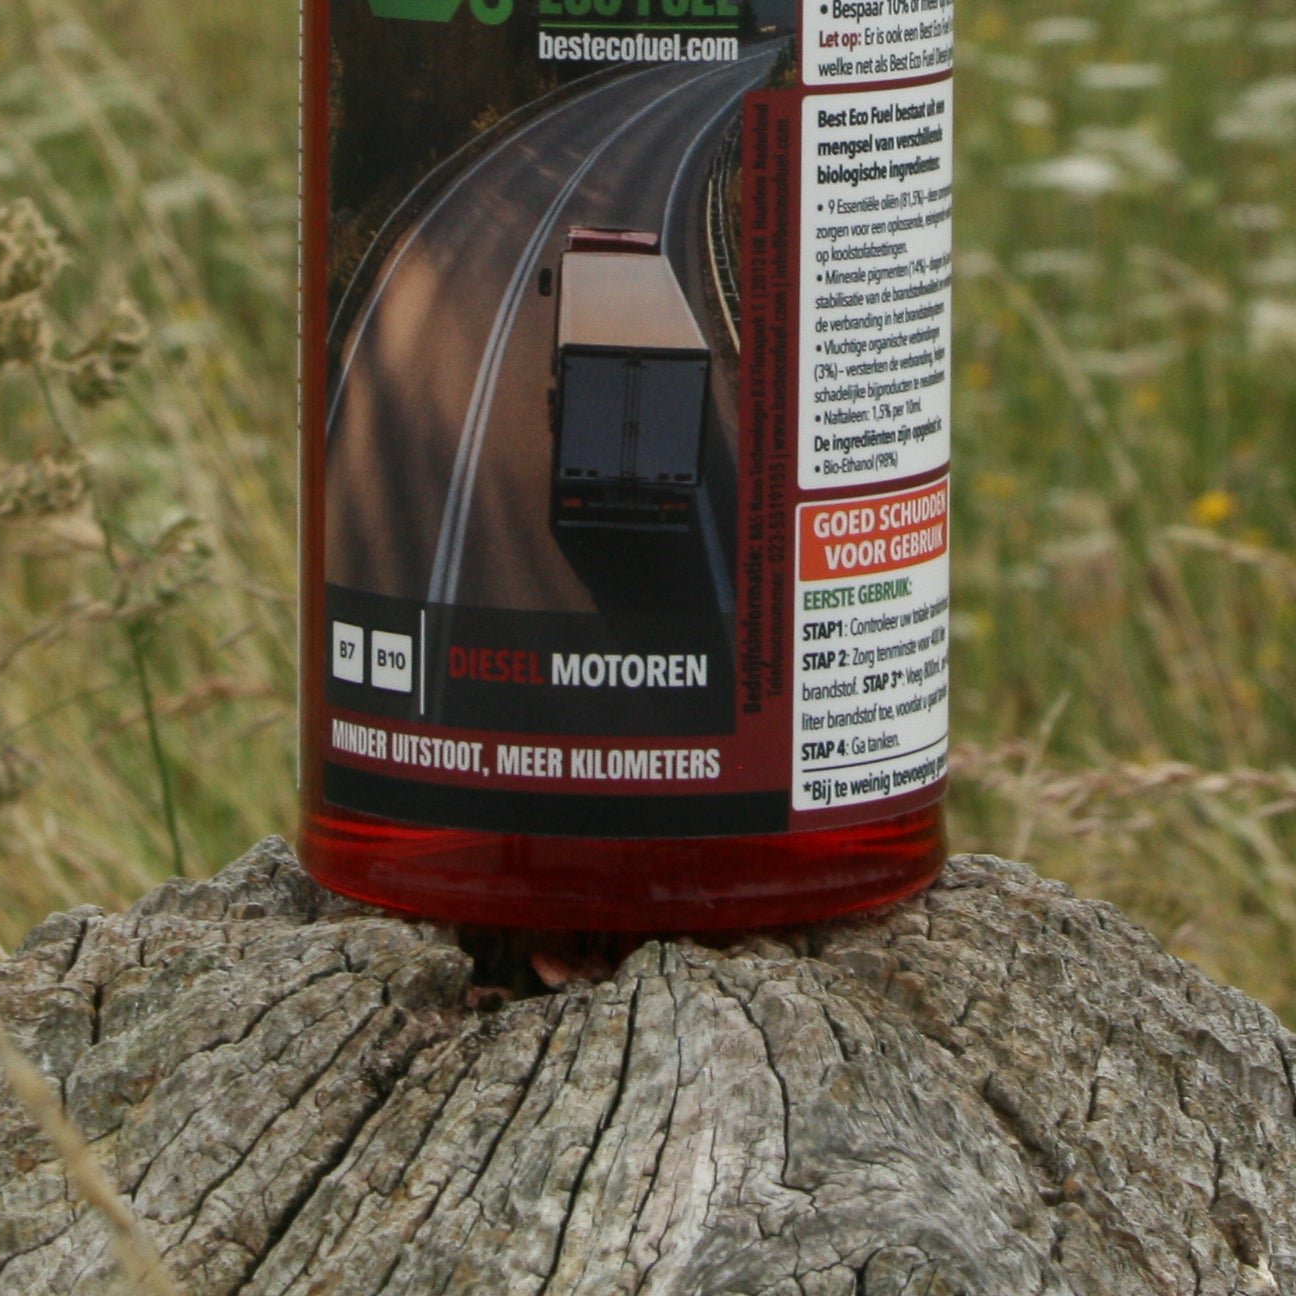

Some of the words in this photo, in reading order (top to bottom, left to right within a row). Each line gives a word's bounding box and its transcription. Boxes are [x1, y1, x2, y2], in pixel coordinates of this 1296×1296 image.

[538, 32, 738, 62] bestecofuel.com
[819, 30, 838, 48] Let
[842, 32, 861, 52] op:
[864, 28, 875, 45] Er
[877, 27, 884, 44] is
[886, 24, 902, 43] ook
[905, 28, 918, 42] een
[819, 58, 852, 76] welke
[855, 58, 873, 74] net
[875, 54, 888, 73] als
[890, 54, 908, 71] Best
[818, 110, 846, 128] Best
[849, 108, 868, 125] Eco
[871, 104, 893, 124] Fuel
[818, 134, 873, 159] mengsel
[875, 136, 894, 151] van
[817, 160, 887, 187] biologische
[828, 199, 834, 214] 9
[816, 225, 849, 242] zorgen
[851, 225, 870, 235] voor
[871, 221, 886, 234] een
[816, 251, 829, 266] op
[825, 267, 866, 284] Minerale
[866, 291, 880, 304] van
[816, 317, 828, 333] de
[830, 312, 883, 331] verbranding
[824, 338, 866, 356] Vluchtige
[814, 362, 837, 382] (3%)
[815, 385, 866, 403] schadelijke
[814, 435, 830, 452] De
[833, 430, 895, 454] ingrediënten
[824, 455, 874, 474] Bio-Ethanol
[814, 508, 875, 538] GOED
[880, 488, 945, 530] SCHUDDEN
[825, 539, 886, 570] VOOR
[890, 523, 944, 560] GEBRUIK
[803, 587, 854, 610] EERSTE
[859, 577, 912, 604] GEBRUIK:
[850, 613, 899, 636] Controleer
[340, 640, 355, 661] B7
[377, 647, 406, 670] B10
[449, 645, 545, 685] DIESEL
[551, 653, 708, 687] MOTOREN
[803, 651, 835, 671] STAP
[852, 648, 874, 668] Zorg
[803, 677, 858, 701] brandstof.
[863, 674, 889, 693] STAP
[802, 710, 825, 731] liter
[827, 703, 877, 728] brandstof
[331, 718, 386, 758] MINDER
[392, 732, 490, 777] UITSTOOT,
[496, 745, 562, 778] MEER
[570, 748, 721, 779] KILOMETERS
[801, 741, 834, 760] STAP
[852, 737, 866, 754] Ga
[835, 779, 847, 798] te
[850, 771, 890, 795] weinig
